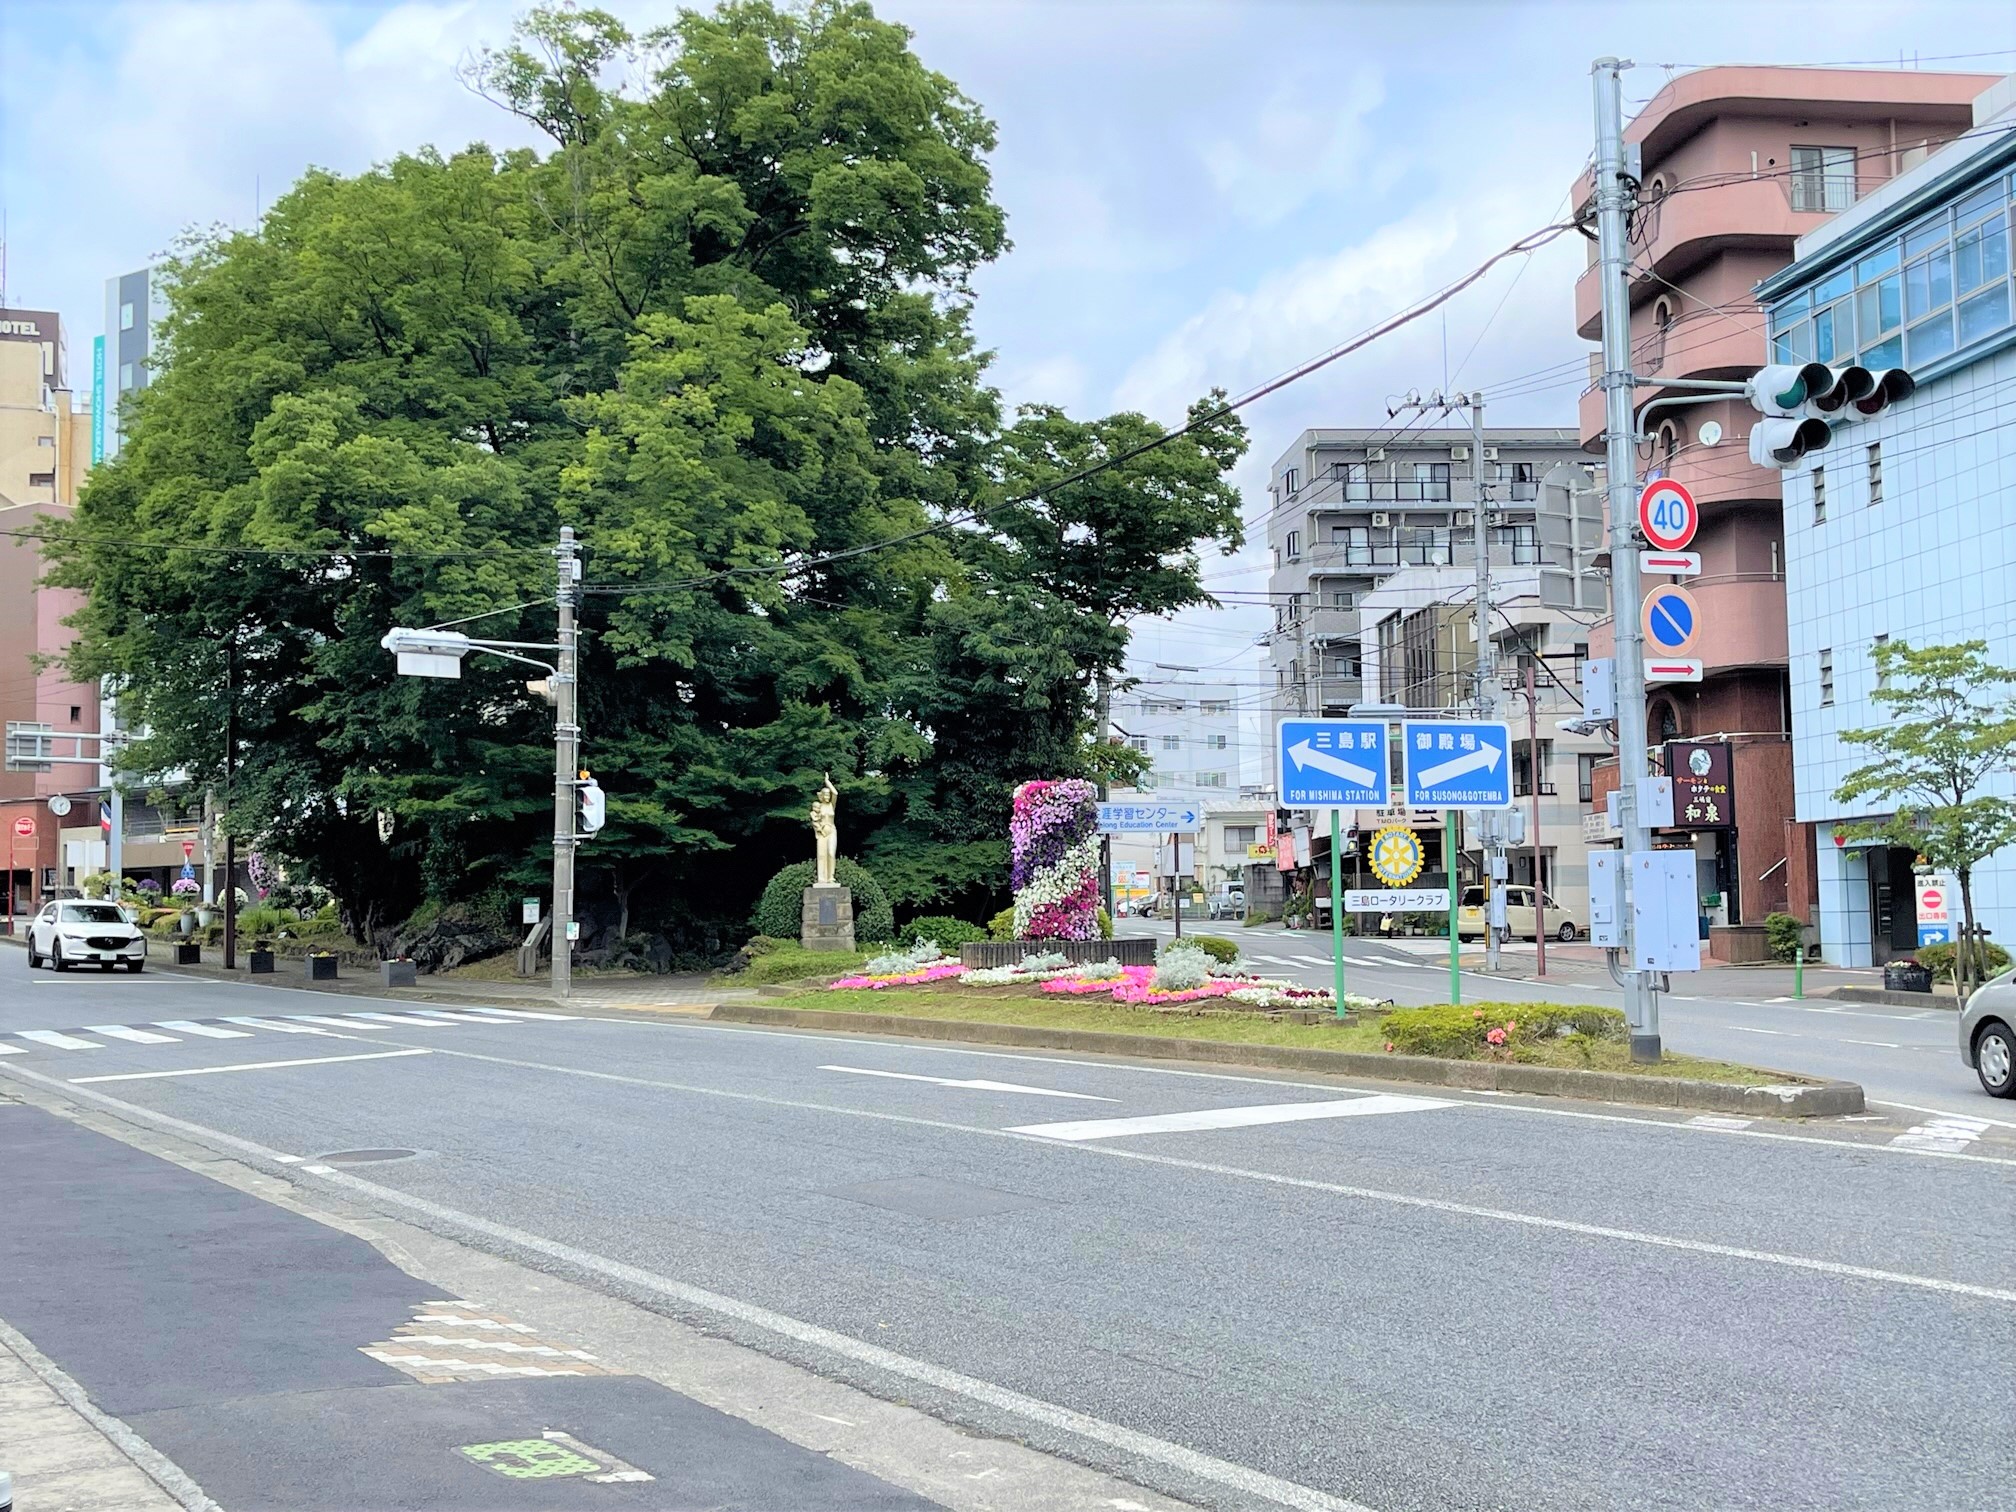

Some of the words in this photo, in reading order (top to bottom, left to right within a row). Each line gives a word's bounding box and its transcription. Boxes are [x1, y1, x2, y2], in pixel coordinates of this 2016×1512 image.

[1653, 499, 1684, 530] 40
[1316, 731, 1377, 750] 三島駅
[1416, 732, 1476, 751] 御殿場
[1290, 790, 1307, 801] FOR
[1308, 790, 1343, 801] MISHIMA
[1345, 790, 1380, 801] STATION
[1415, 790, 1430, 801] FOR
[1432, 790, 1503, 801] SUSONO&GOTEMBA
[1685, 803, 1721, 823] 和泉
[1120, 821, 1153, 829] Education
[1155, 821, 1178, 829] Center
[1351, 894, 1444, 907] 三島ロータリークラブ
